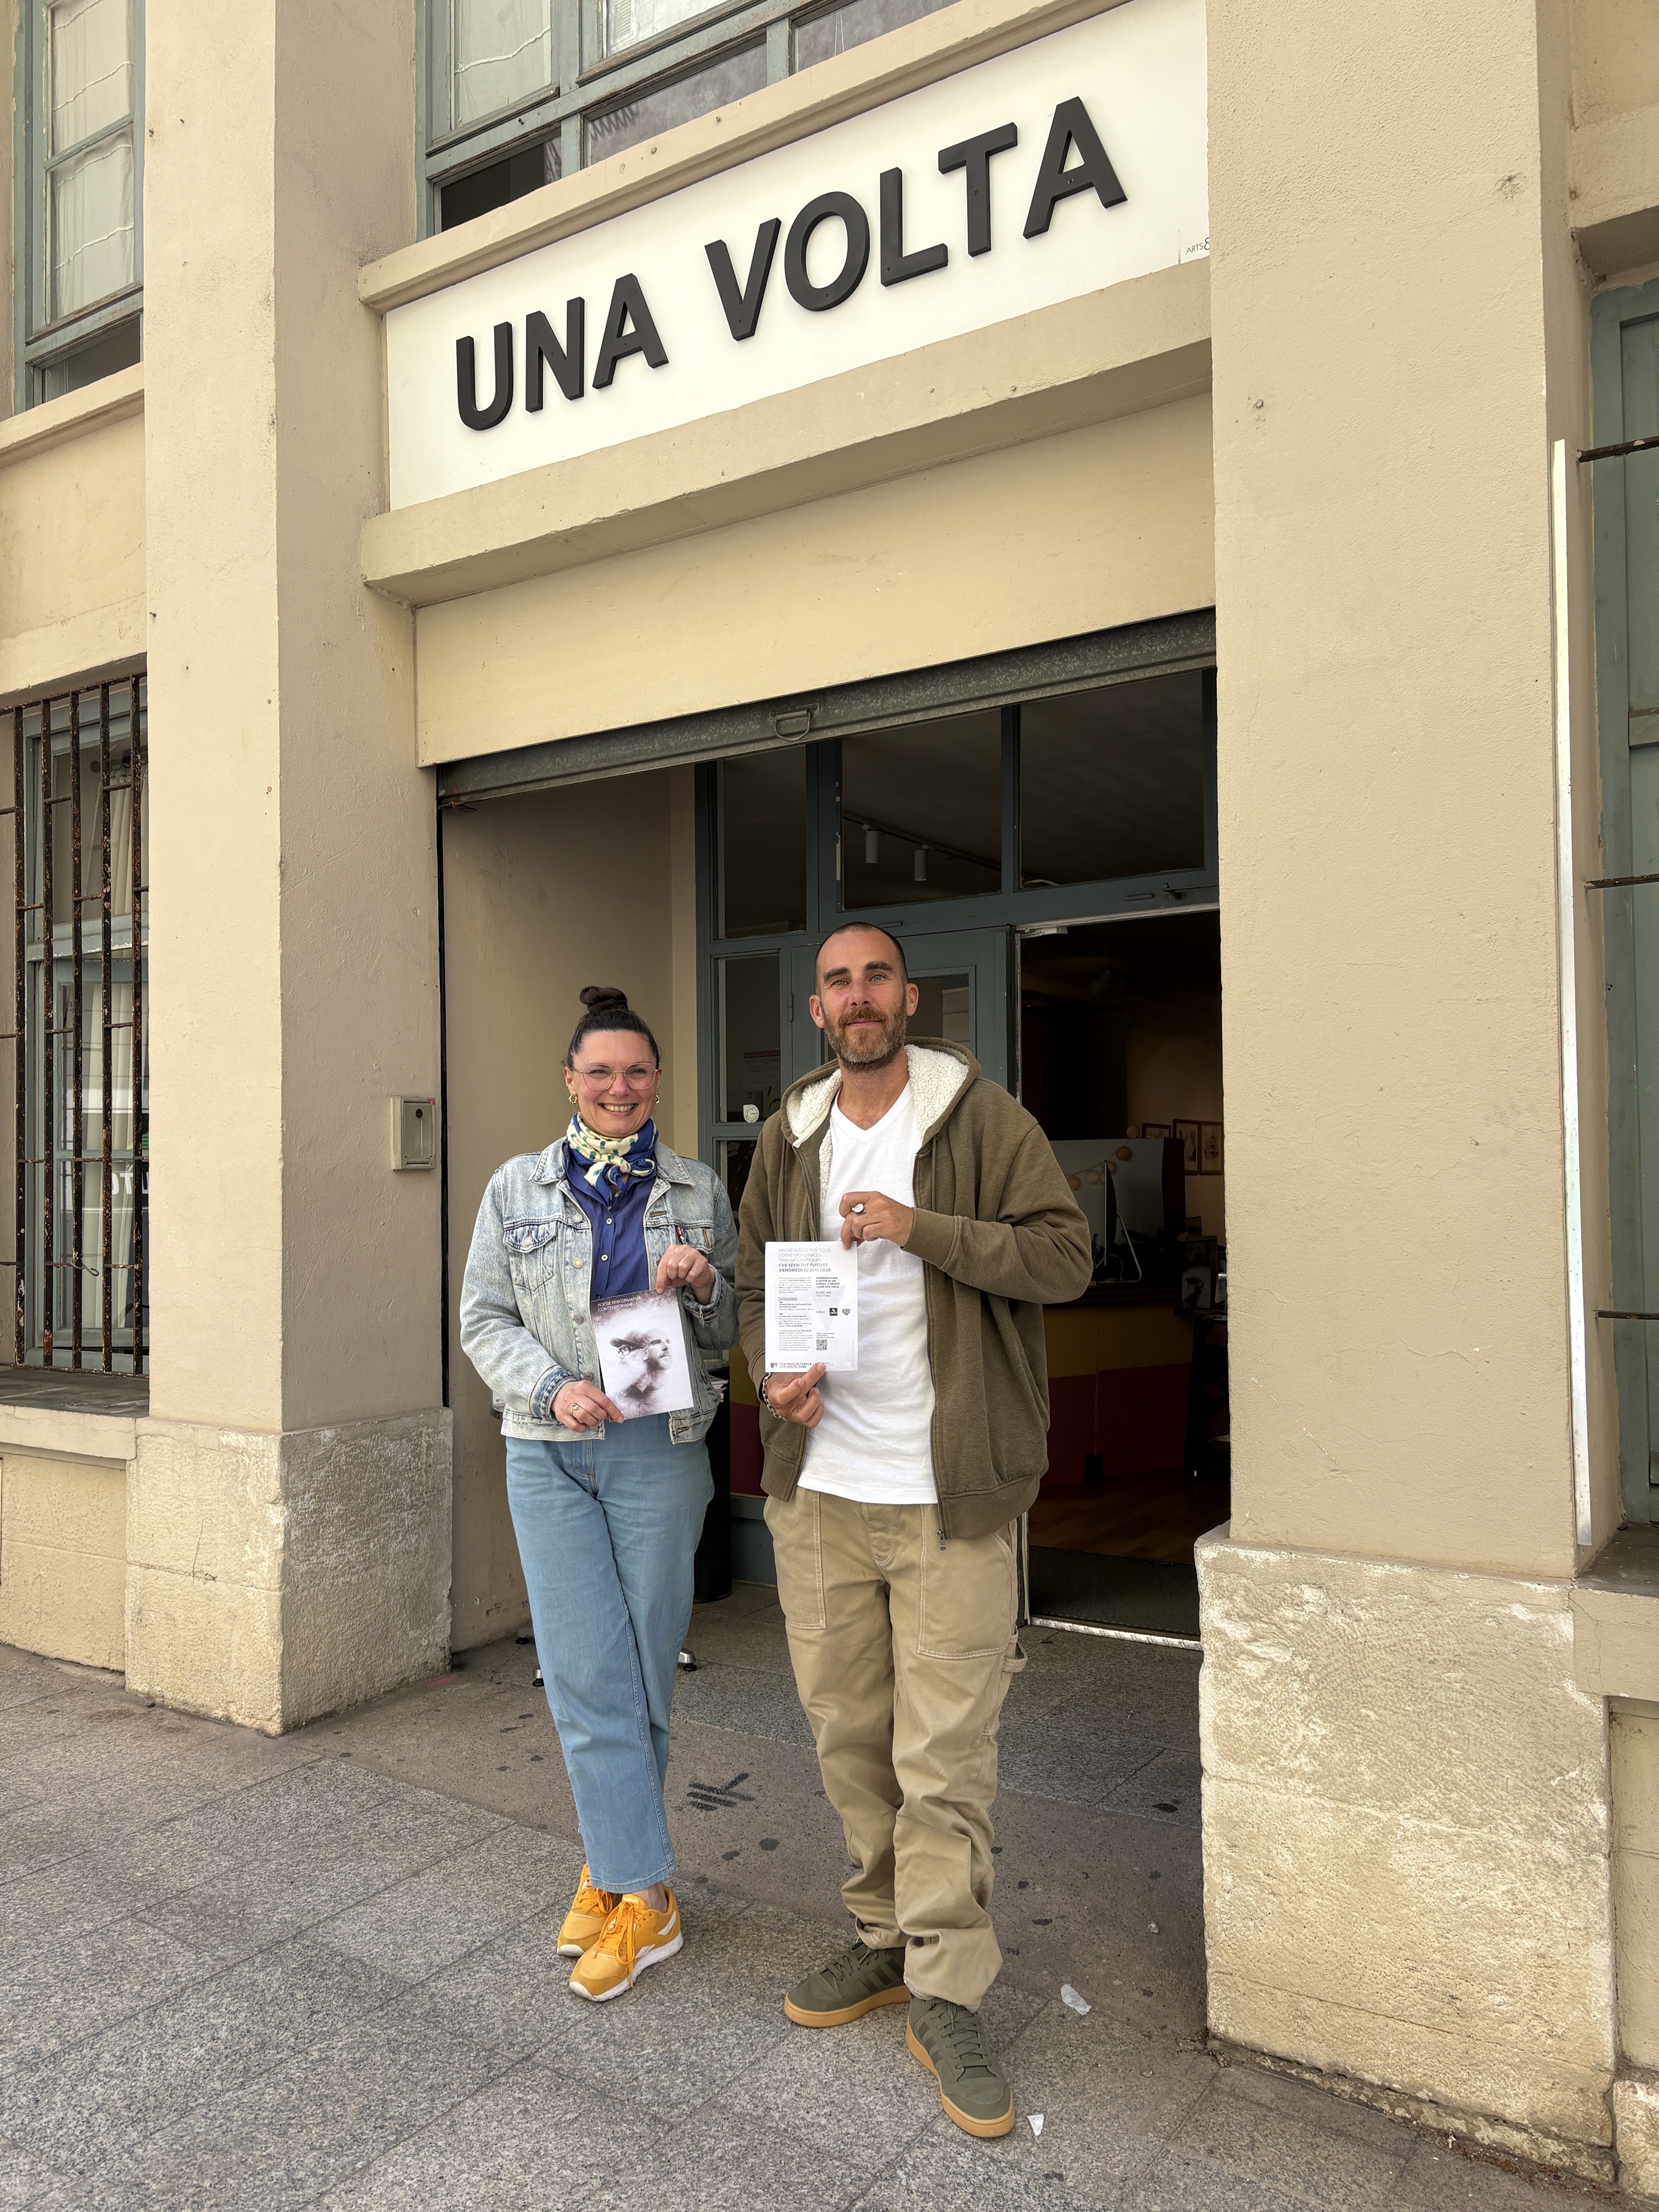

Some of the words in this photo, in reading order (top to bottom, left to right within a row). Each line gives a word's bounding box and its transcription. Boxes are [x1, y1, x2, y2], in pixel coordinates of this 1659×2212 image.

[456, 273, 670, 431] UNA
[704, 96, 1129, 342] VOLTA
[598, 1302, 633, 1312] CONTEMPORAINE
